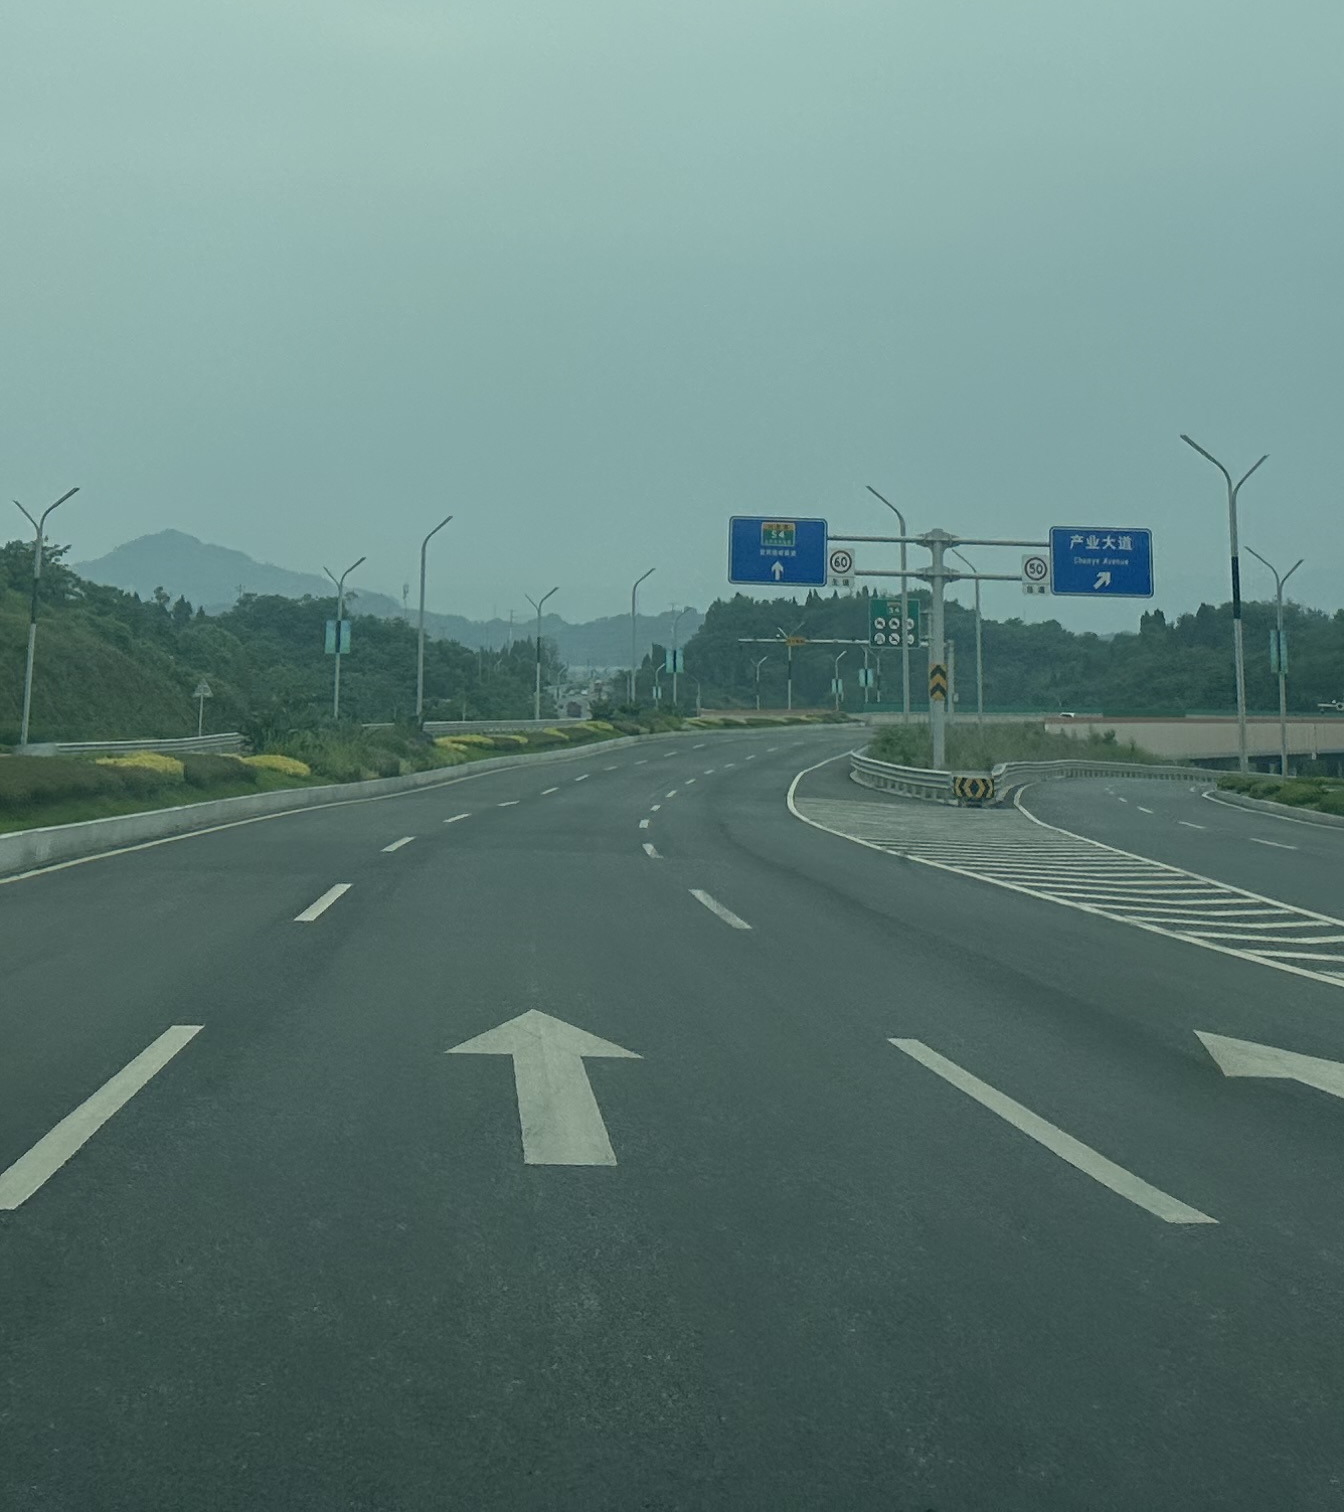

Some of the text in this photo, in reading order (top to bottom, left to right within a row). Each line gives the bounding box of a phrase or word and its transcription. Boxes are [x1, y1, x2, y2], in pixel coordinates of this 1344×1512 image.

[771, 530, 785, 539] S4
[1070, 534, 1133, 551] 产业大道
[834, 556, 848, 568] 60
[1029, 563, 1043, 575] 50
